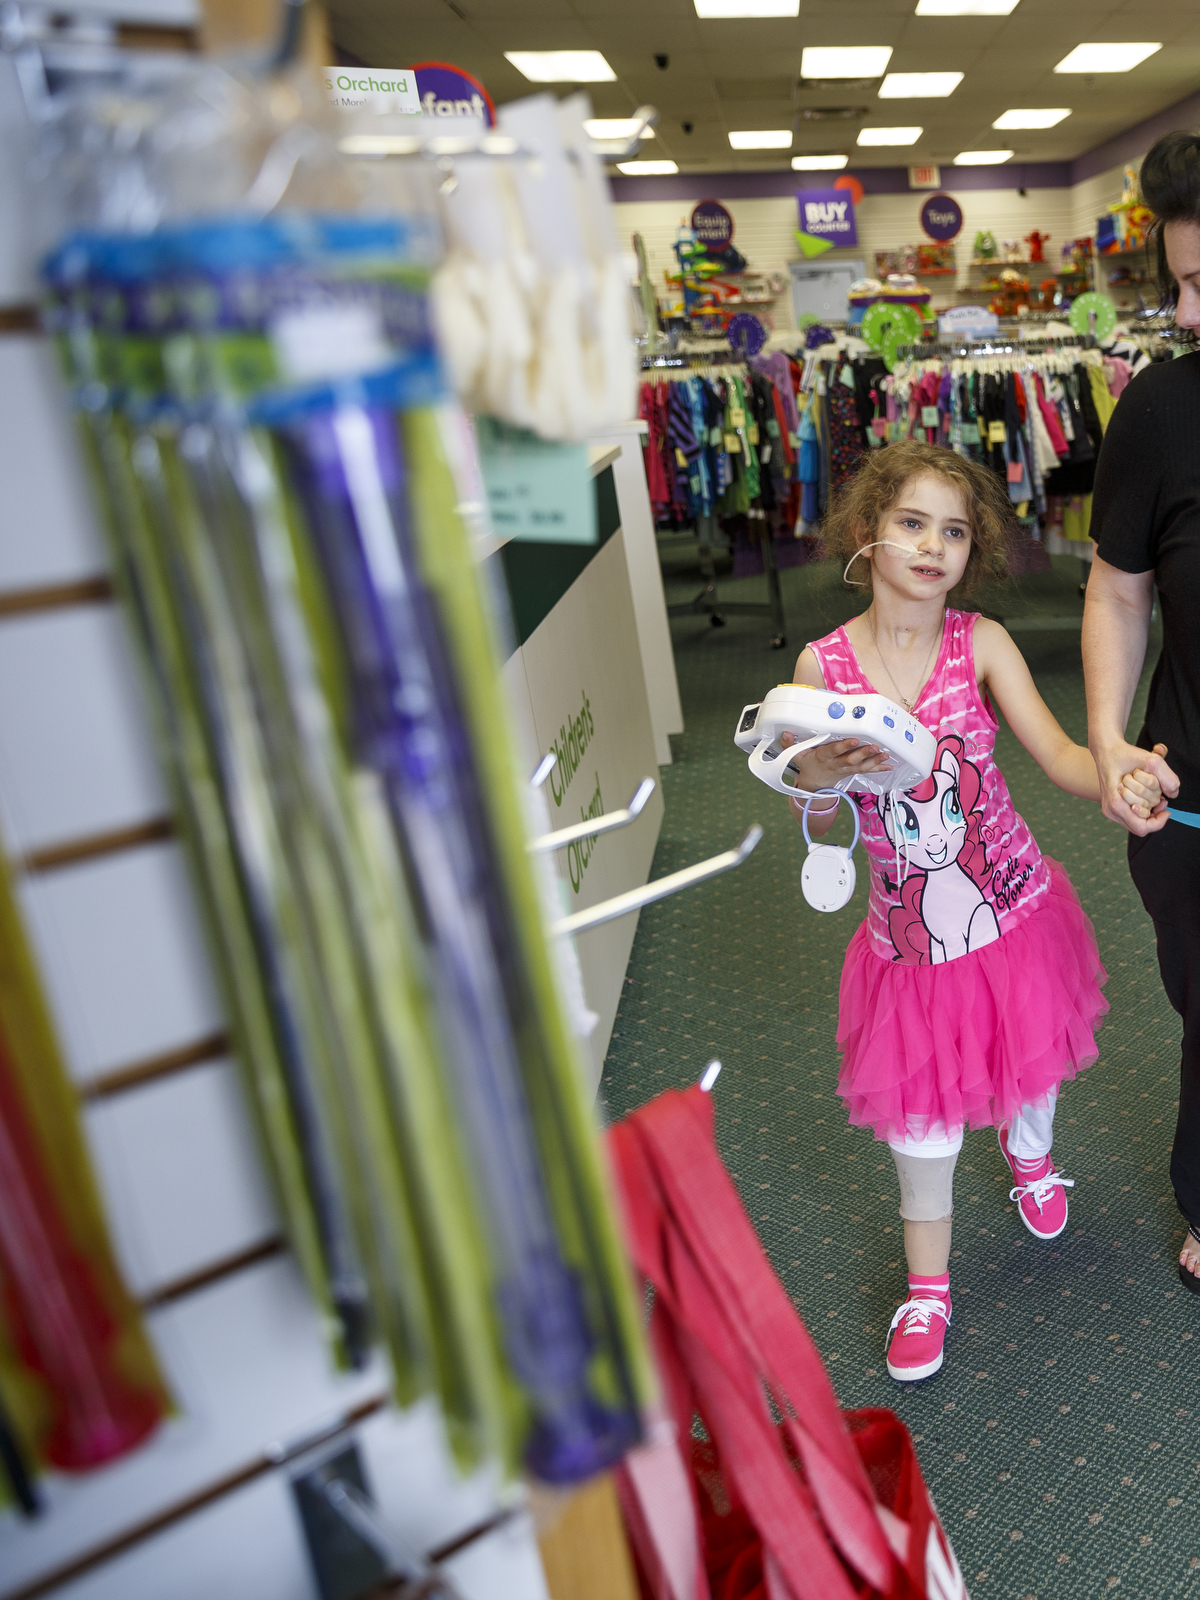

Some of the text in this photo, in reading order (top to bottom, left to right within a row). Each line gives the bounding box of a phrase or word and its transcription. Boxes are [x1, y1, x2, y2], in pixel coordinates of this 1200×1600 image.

[336, 75, 409, 93] Orchard
[694, 213, 730, 229] Equip
[804, 201, 848, 224] BUY
[927, 209, 957, 228] Toys
[806, 220, 851, 233] COUNTER
[549, 689, 595, 808] Children's
[991, 855, 1020, 898] Cutie
[996, 863, 1033, 911] Power
